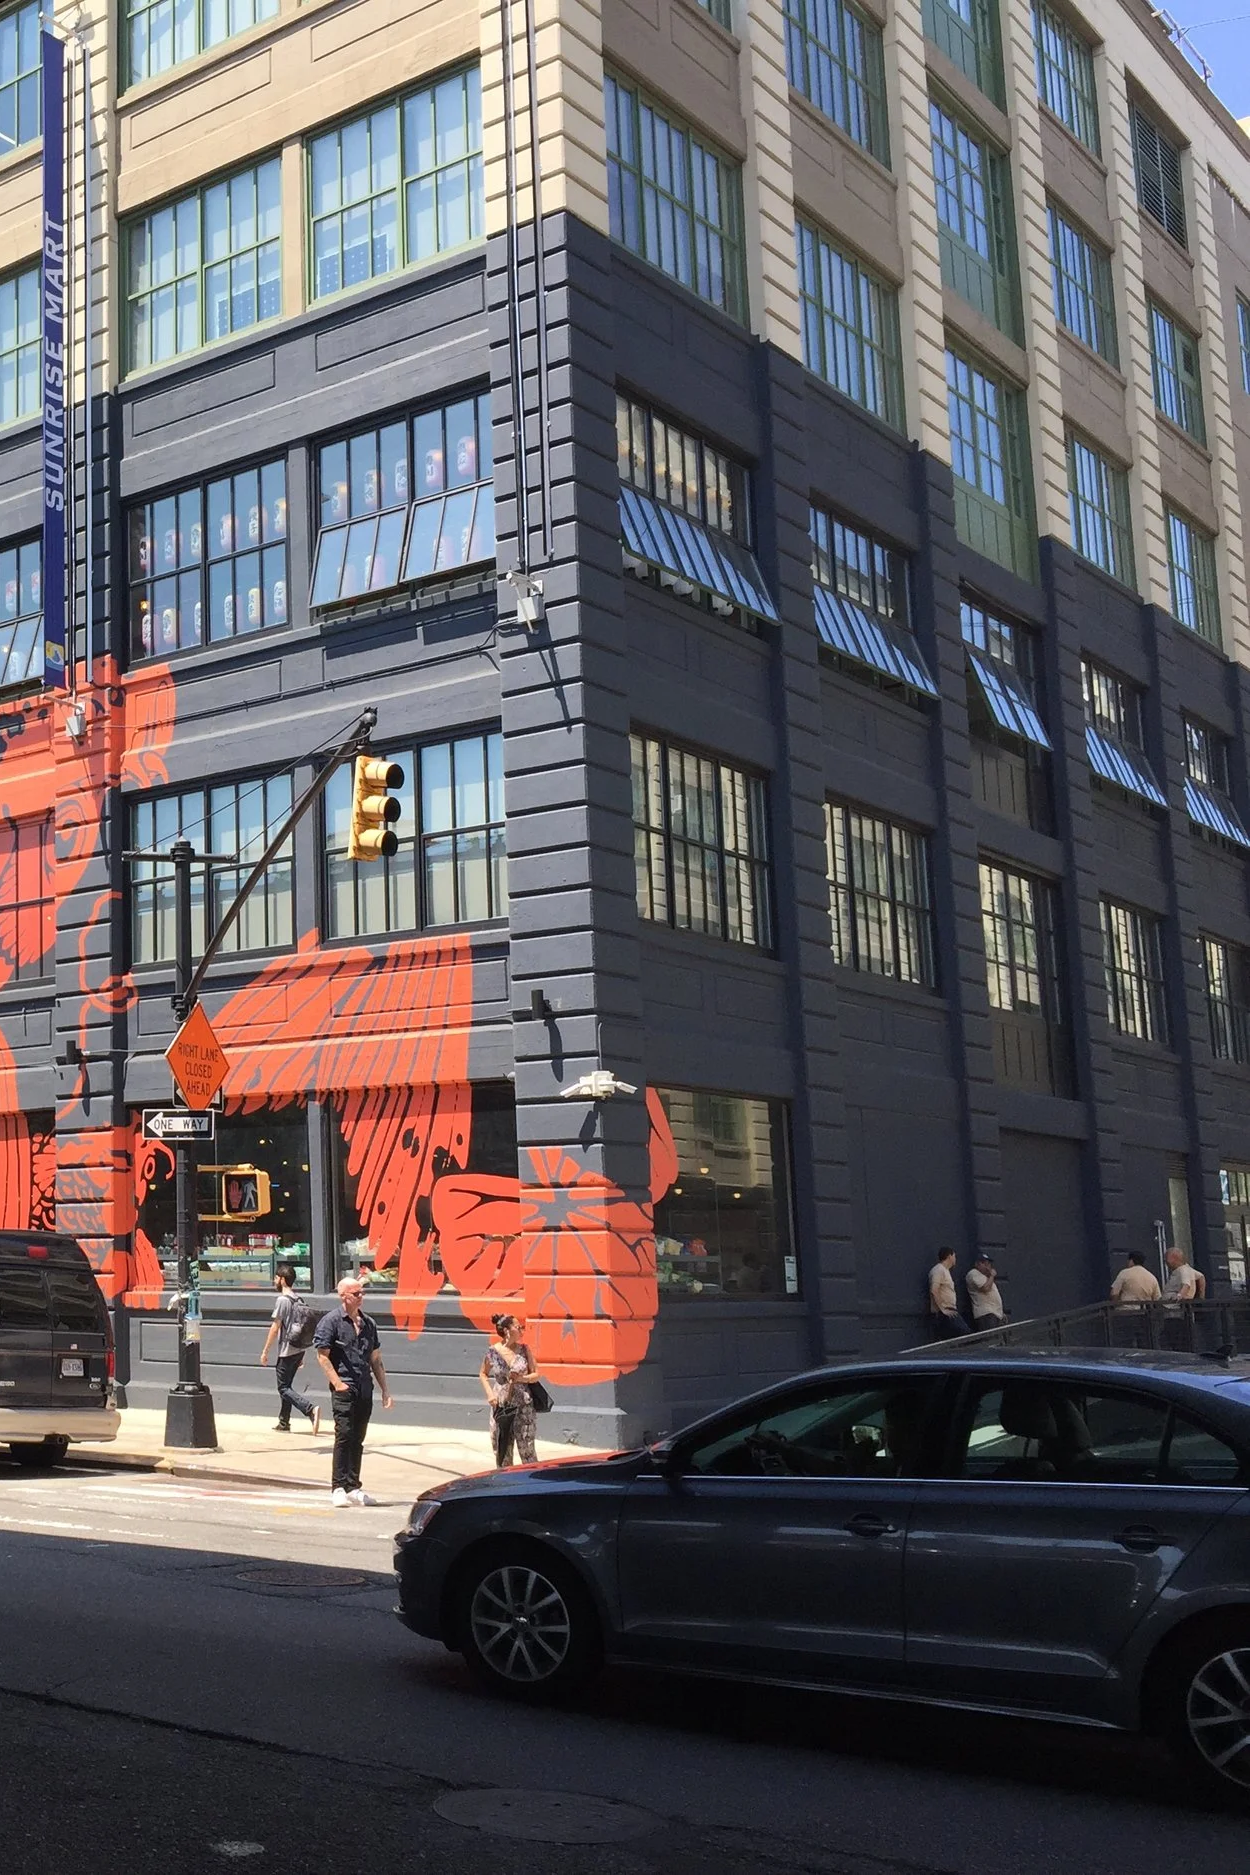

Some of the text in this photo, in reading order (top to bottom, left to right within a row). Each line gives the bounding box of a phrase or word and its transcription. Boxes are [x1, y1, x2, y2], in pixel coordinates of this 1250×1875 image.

[45, 211, 64, 512] SUNRISE MART
[178, 1042, 219, 1063] RIGHT LANE
[185, 1061, 212, 1079] CLOSED
[186, 1081, 211, 1096] AHEAD
[153, 1119, 204, 1130] ONE WAY
